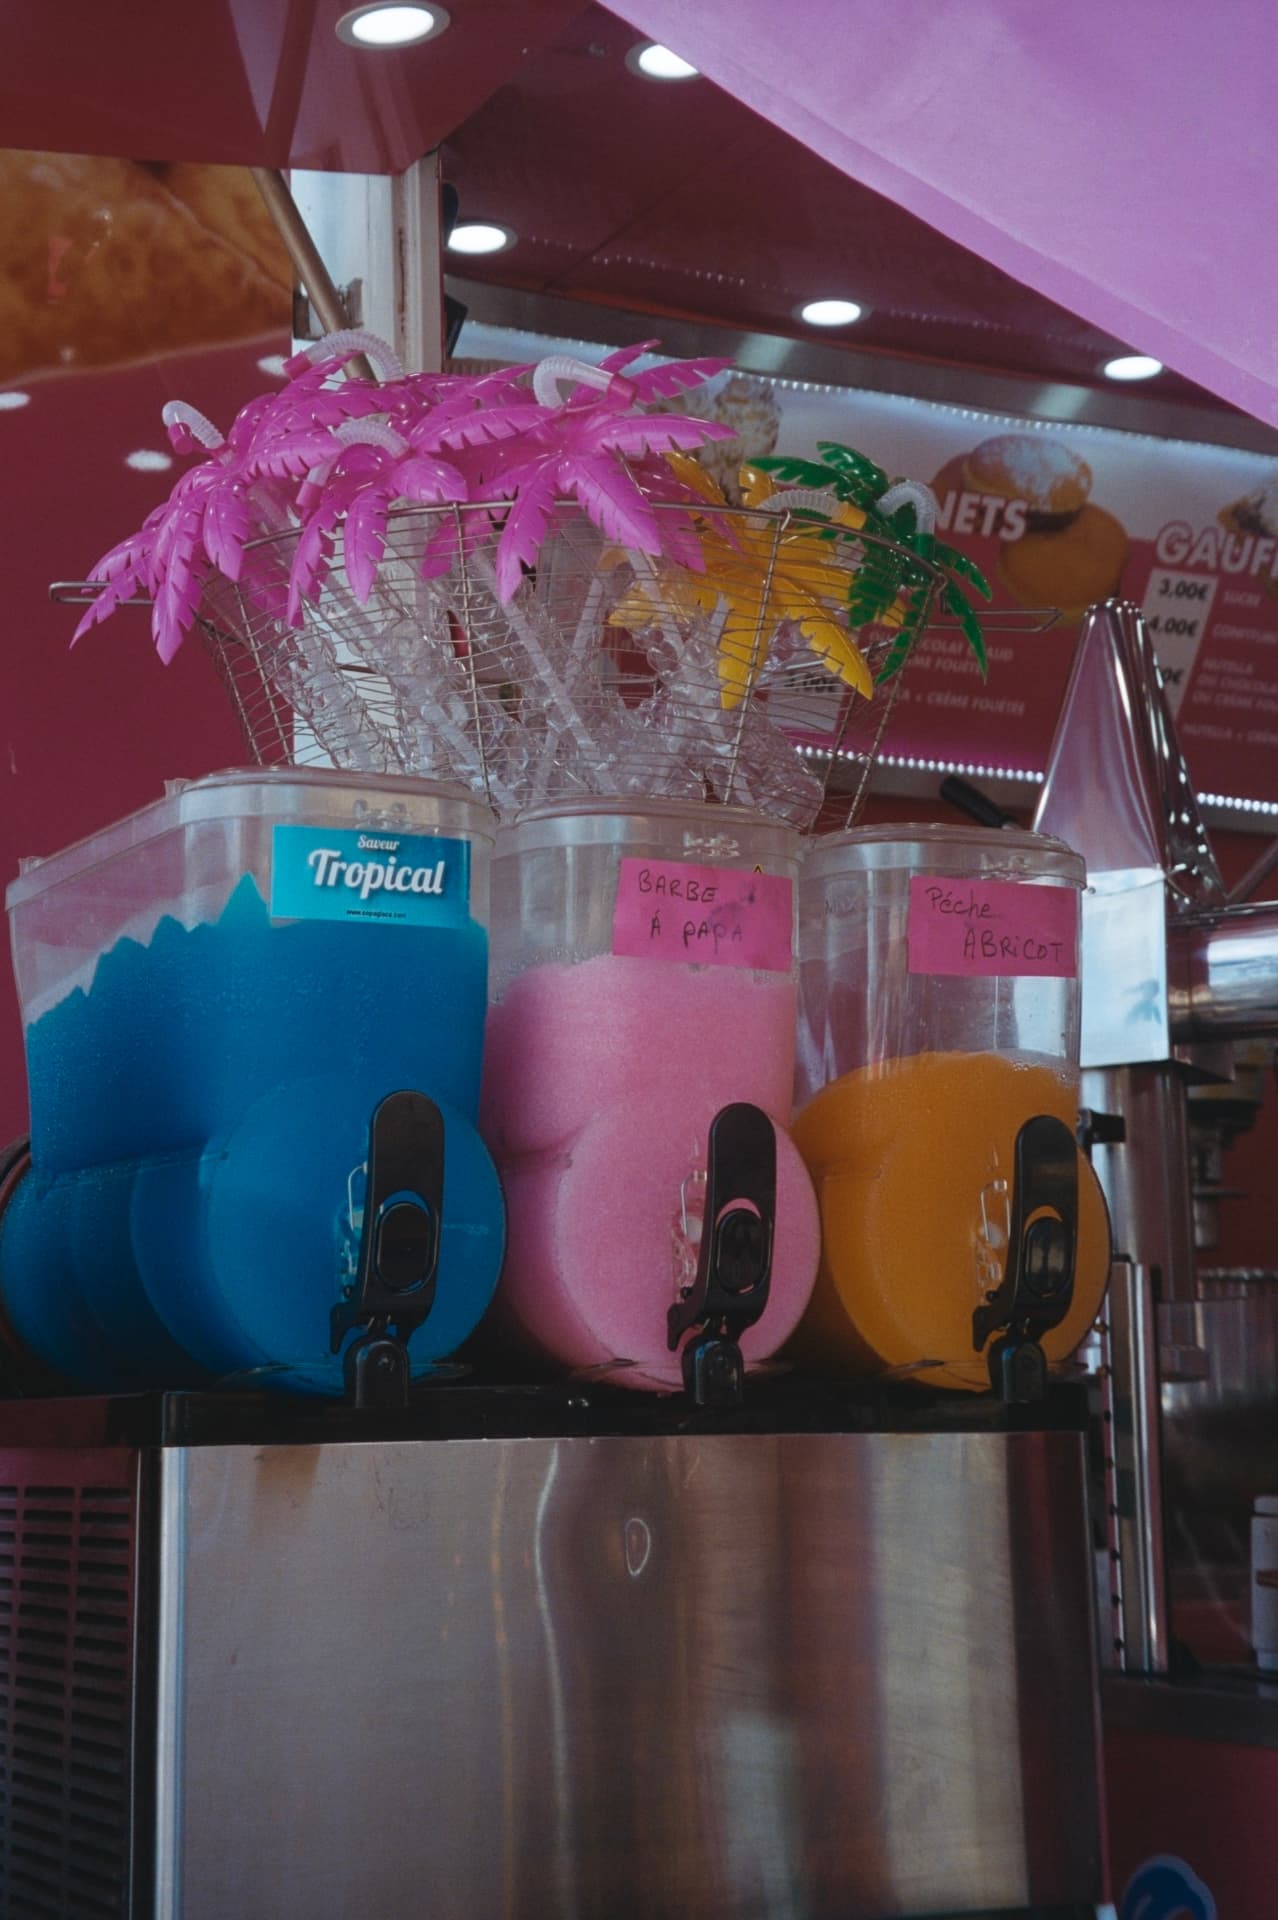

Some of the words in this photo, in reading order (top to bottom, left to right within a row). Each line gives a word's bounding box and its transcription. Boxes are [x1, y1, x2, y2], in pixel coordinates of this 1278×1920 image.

[357, 834, 400, 851] Saveur
[308, 849, 446, 899] Tropical
[638, 869, 719, 903] BARBE
